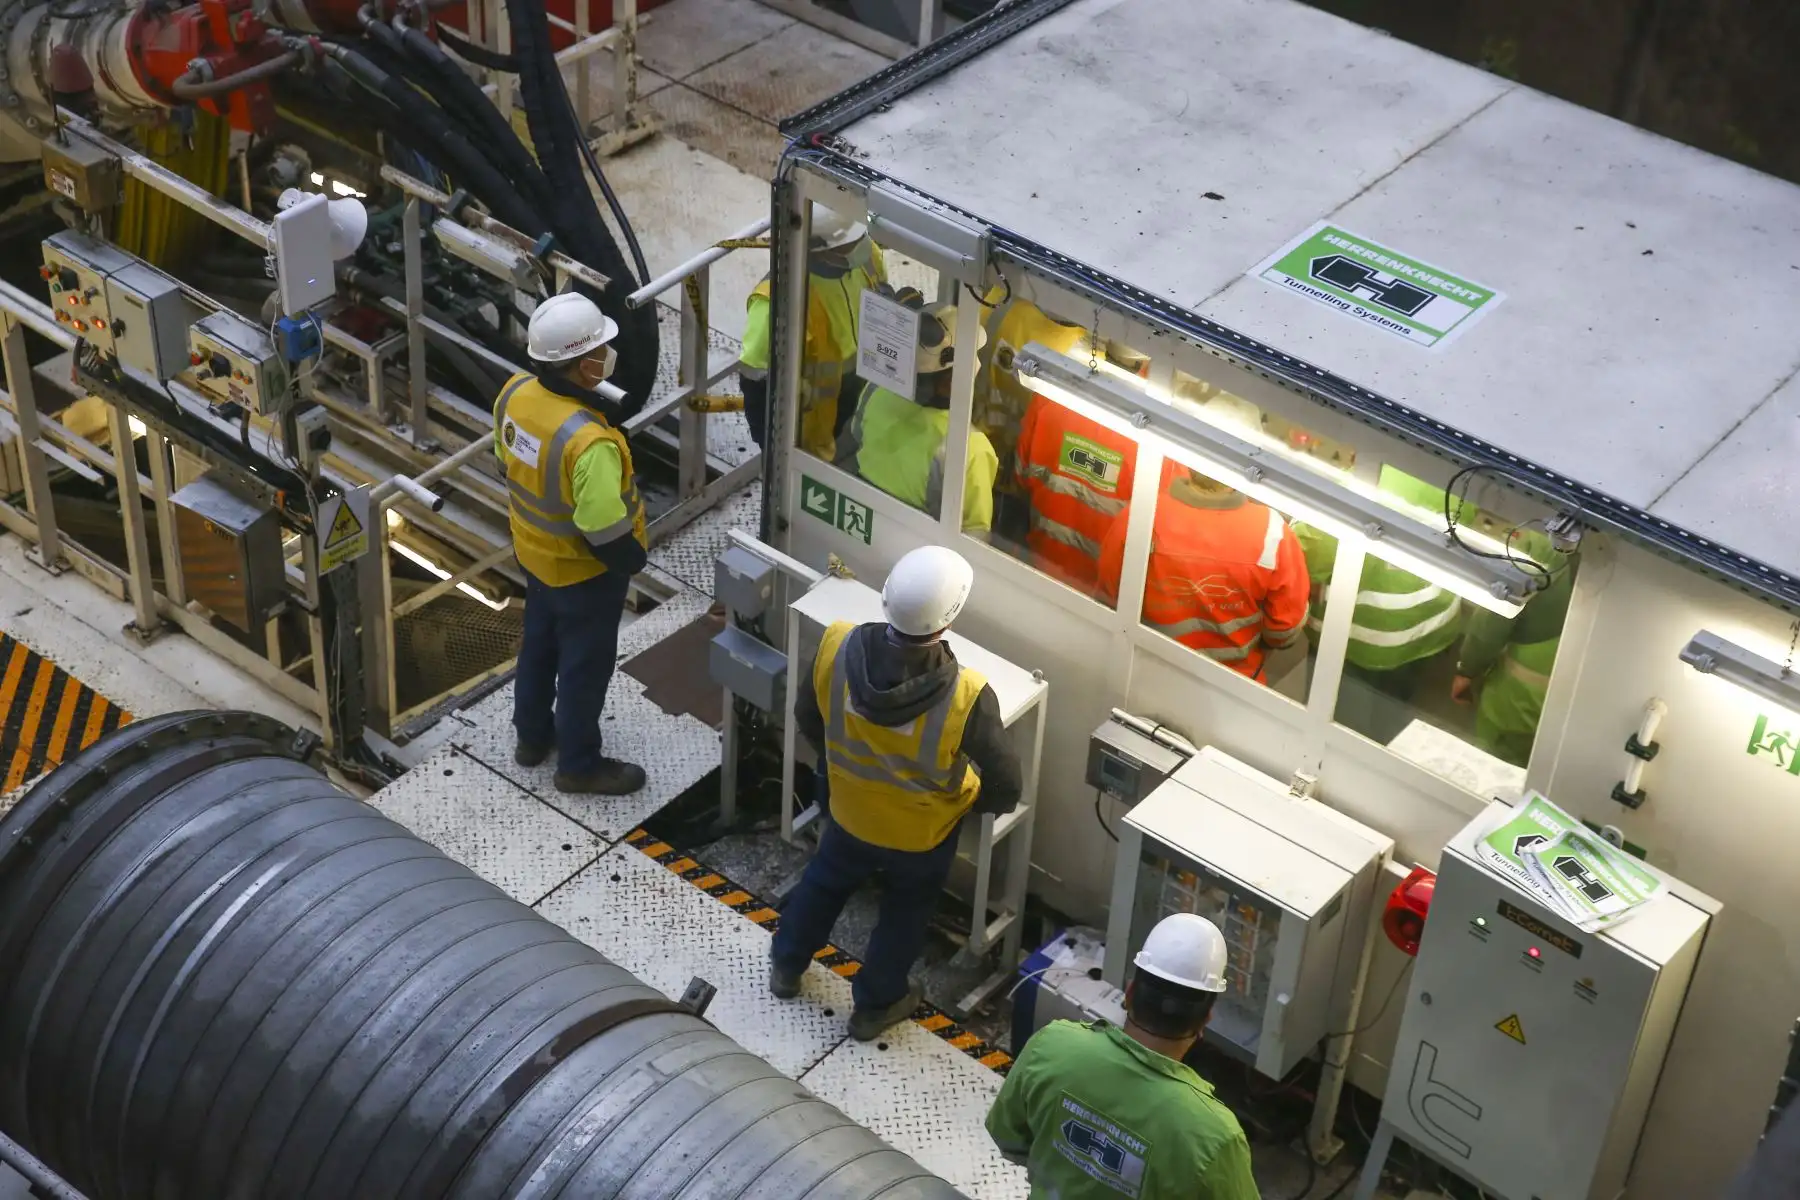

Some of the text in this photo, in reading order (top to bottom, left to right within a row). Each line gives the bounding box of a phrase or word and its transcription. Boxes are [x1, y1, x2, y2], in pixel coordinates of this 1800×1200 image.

[1322, 234, 1483, 302] HERRENKNECHT
[1283, 276, 1411, 335] Tunnelling Systems
[564, 335, 591, 350] webuild
[1490, 852, 1540, 889] Tunnelling
